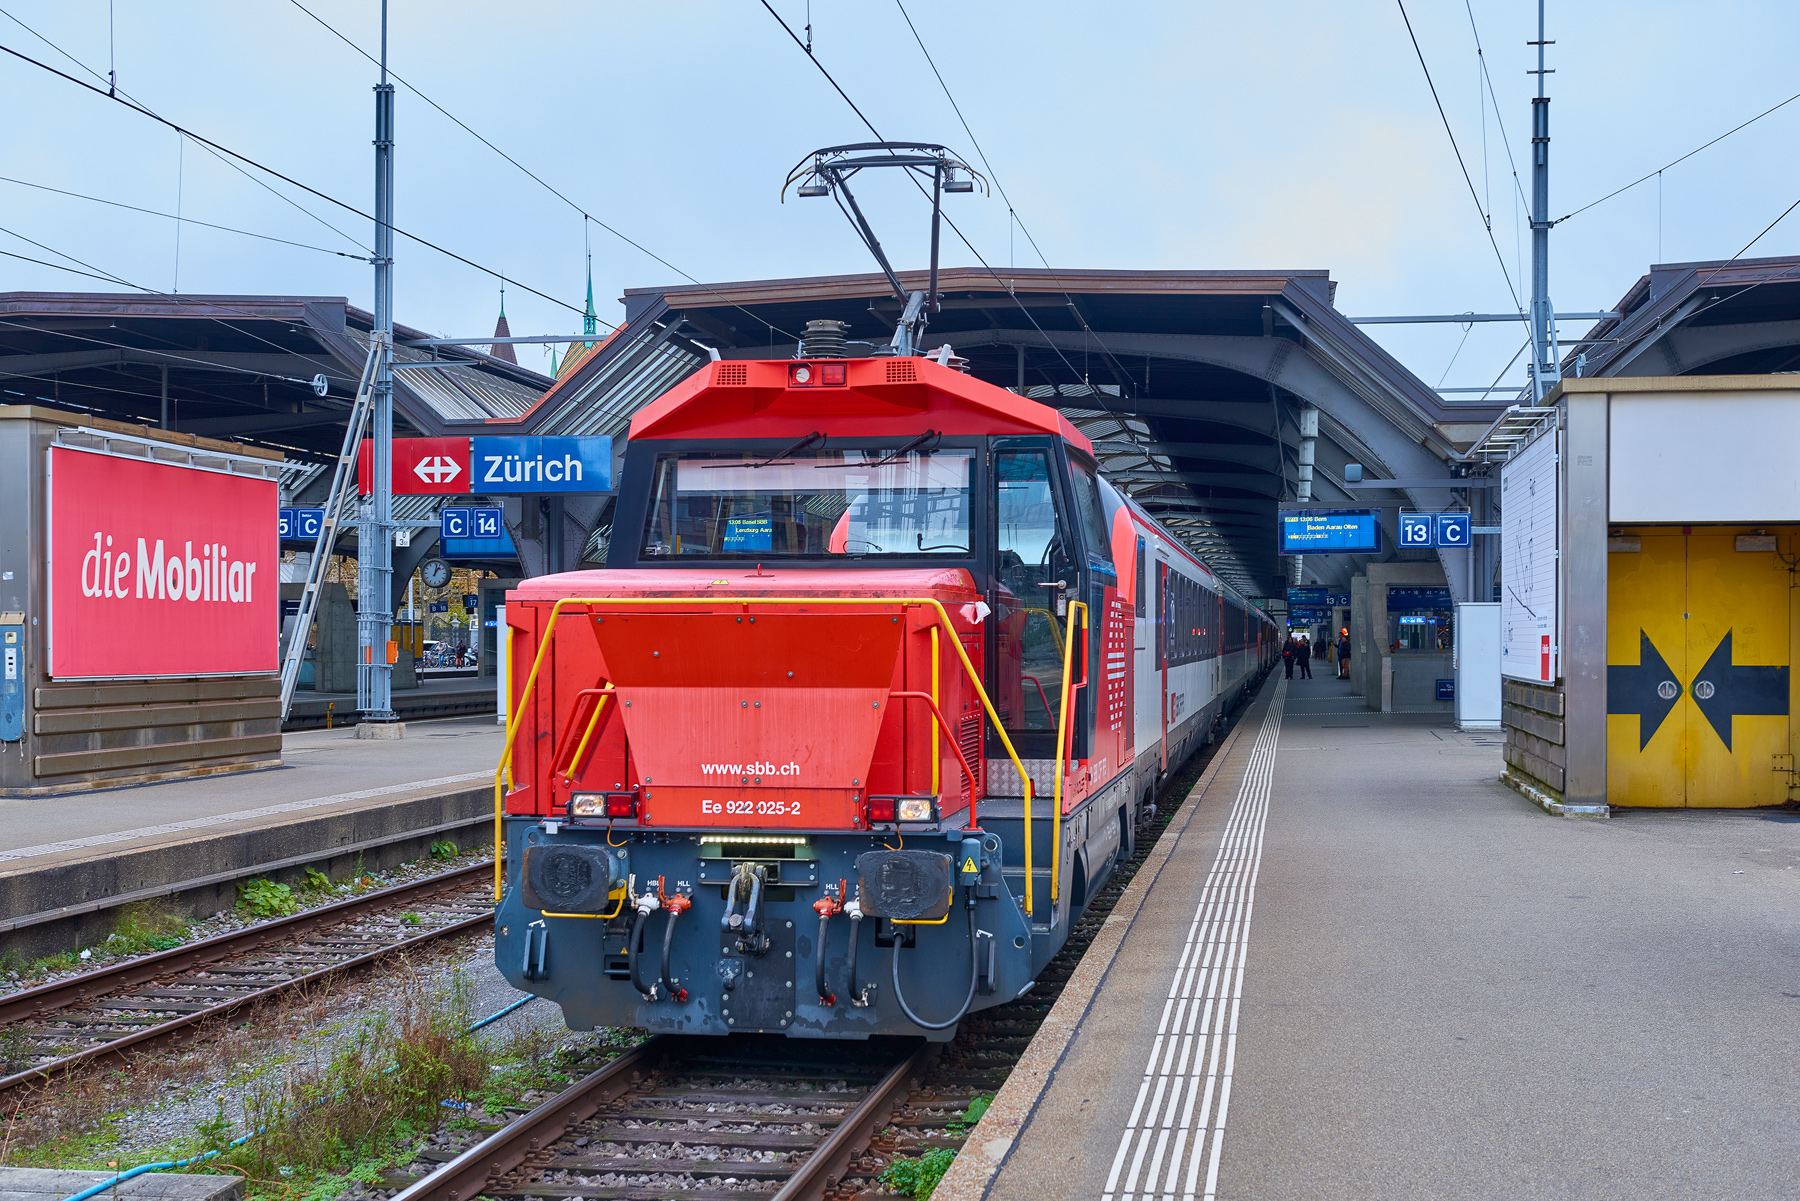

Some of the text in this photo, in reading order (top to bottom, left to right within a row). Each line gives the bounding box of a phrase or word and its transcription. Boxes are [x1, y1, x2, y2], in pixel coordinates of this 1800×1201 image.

[484, 454, 582, 482] Zürich
[305, 519, 317, 534] C
[450, 518, 462, 534] C
[478, 518, 496, 533] 14
[1405, 525, 1427, 542] 13
[1446, 525, 1461, 542] C
[81, 532, 257, 603] die Mobiliar
[1326, 597, 1335, 605] 13
[1340, 597, 1347, 605] C
[701, 761, 800, 776] www.sbb.ch
[702, 799, 801, 815] Ee 922 025-2
